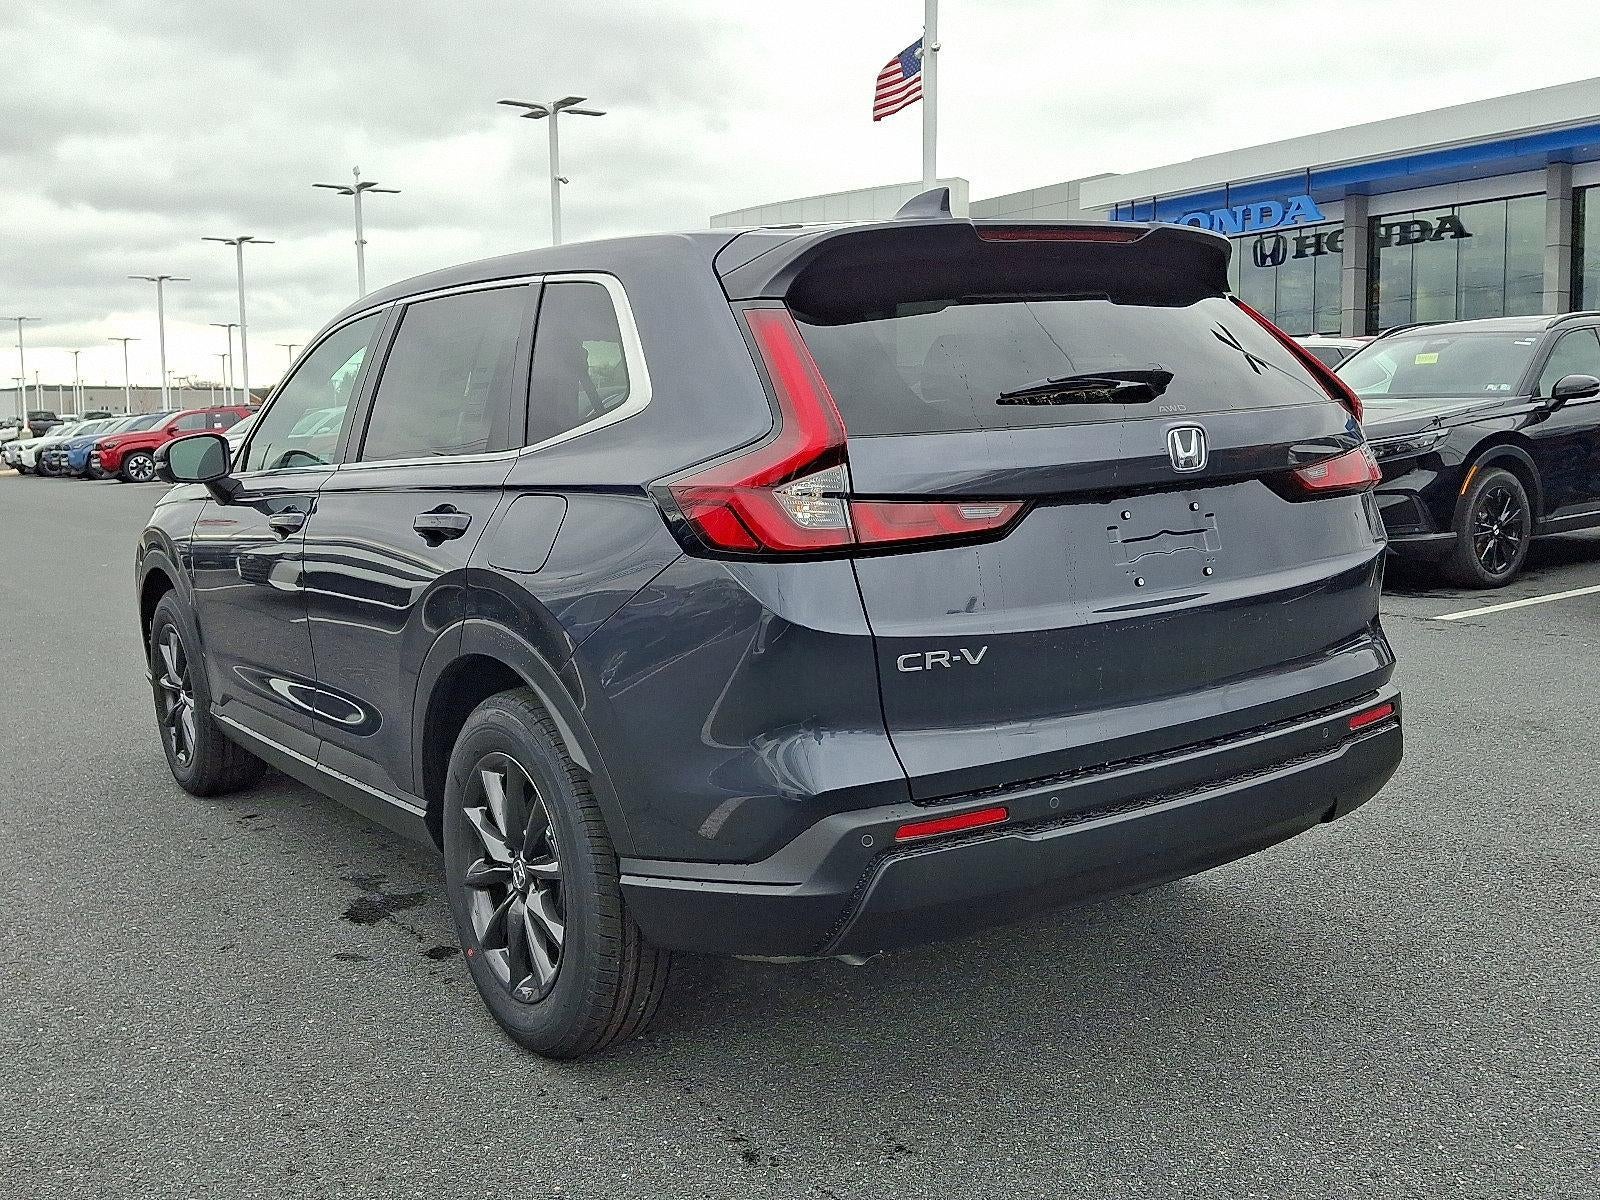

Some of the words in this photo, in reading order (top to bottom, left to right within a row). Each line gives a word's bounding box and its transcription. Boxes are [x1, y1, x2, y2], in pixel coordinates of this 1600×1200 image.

[1174, 195, 1325, 234] ONDA
[1159, 404, 1187, 413] AWD
[896, 645, 988, 672] CR-V
